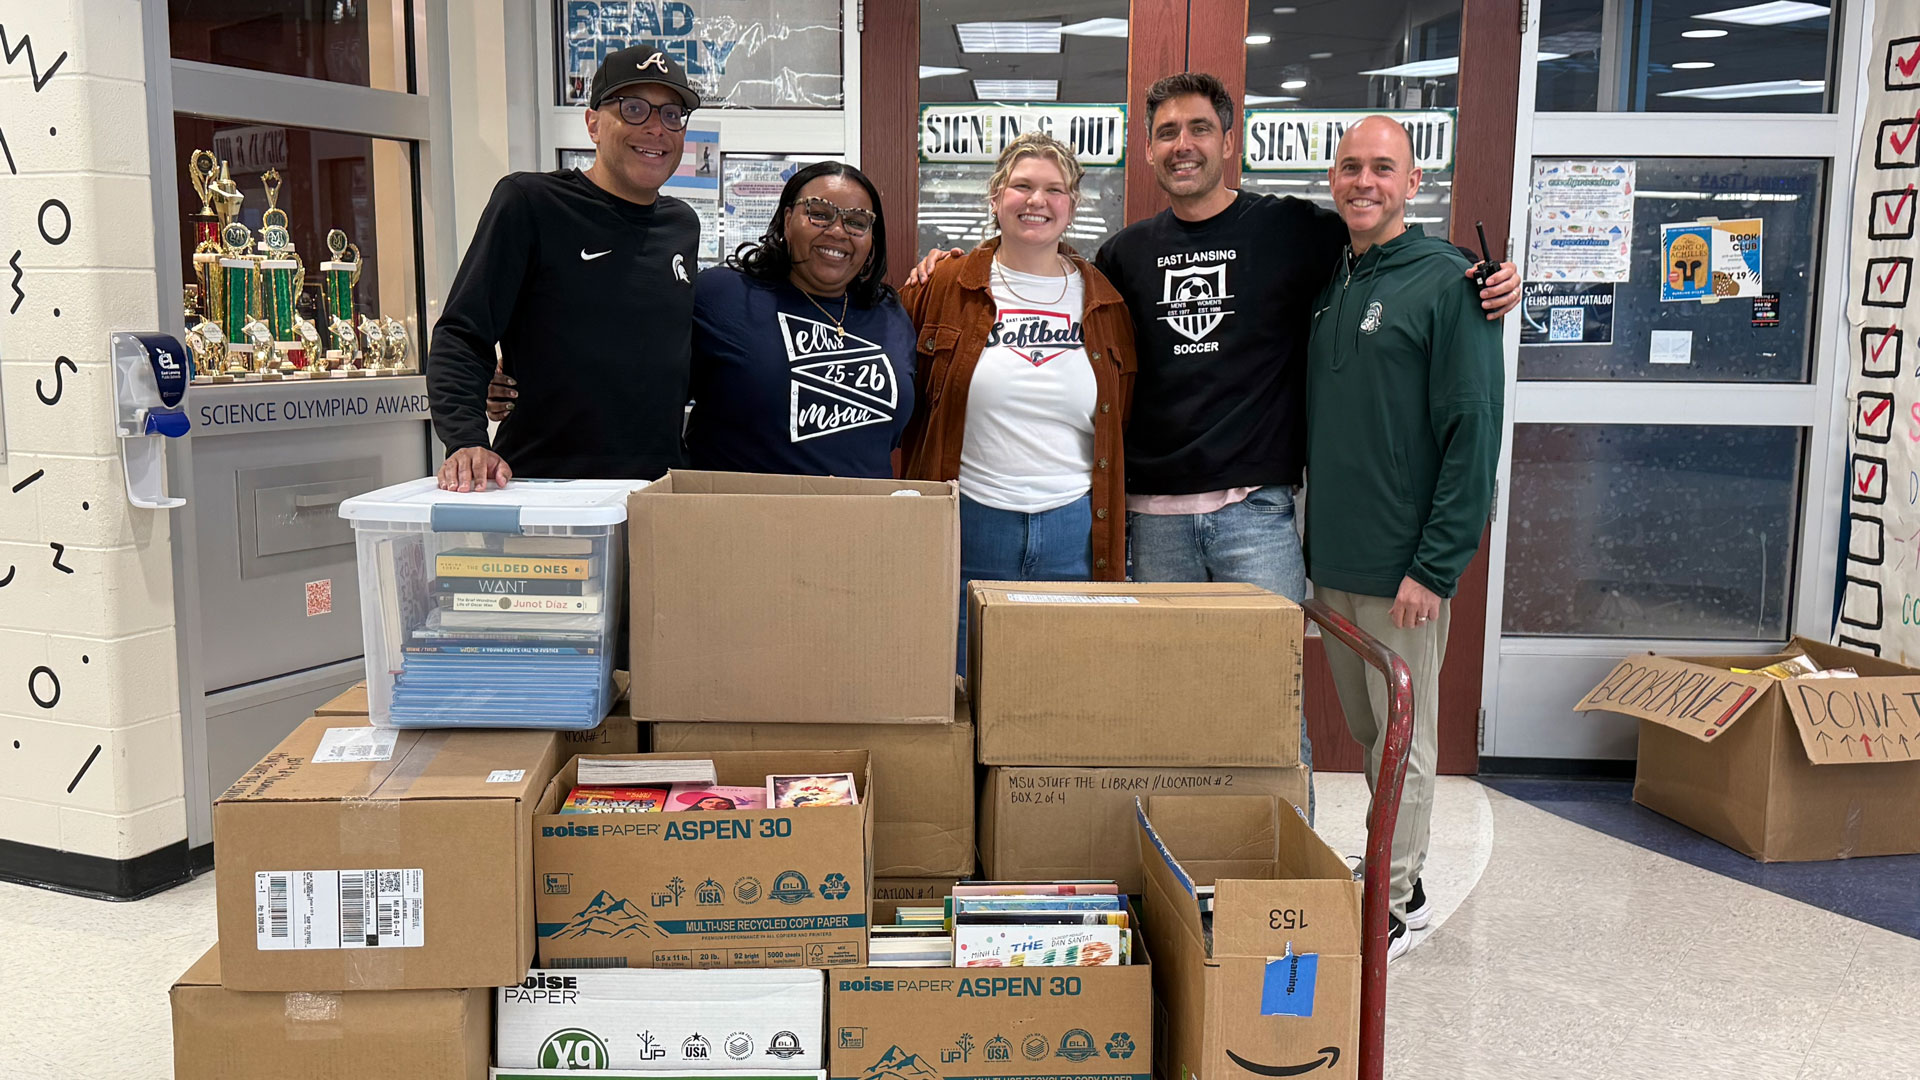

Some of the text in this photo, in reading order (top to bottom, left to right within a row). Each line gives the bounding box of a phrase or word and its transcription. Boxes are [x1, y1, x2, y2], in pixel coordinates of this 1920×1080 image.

[568, 1, 694, 36] READ
[636, 52, 669, 74] A
[926, 114, 984, 155] SIGN
[1070, 115, 1119, 156] OUT
[1250, 121, 1311, 162] SIGN
[1730, 233, 1758, 242] BOOK
[1672, 243, 1693, 252] SONG
[1732, 242, 1758, 251] CLUB
[1157, 249, 1237, 267] EAST LANSING
[1670, 250, 1708, 258] ACHILLES
[1713, 271, 1747, 280] MAY 19
[1528, 294, 1612, 306] ELHS LIBRARY CATALOG
[985, 320, 1086, 349] Softball
[1173, 341, 1219, 355] SOCCER
[824, 363, 886, 391] 25-26
[201, 402, 276, 426] SCIENCE
[283, 397, 368, 421] OLYMPIAD
[481, 563, 529, 573] GILDED
[533, 565, 568, 574] ONES
[478, 580, 528, 593] WANT
[513, 599, 542, 609] Junot
[545, 599, 568, 609] Díaz
[1009, 776, 1035, 789] MSU
[1038, 776, 1071, 789] STUFF
[1073, 776, 1095, 789] THE
[1101, 776, 1149, 790] LIBRARY
[1224, 774, 1234, 786] 2
[1011, 792, 1066, 804] BOX 2 of 4
[663, 819, 751, 841] ASPEN
[759, 818, 792, 838] 30
[699, 892, 721, 904] USA
[927, 885, 935, 900] 1
[651, 895, 673, 907] UP
[686, 916, 849, 932] MULTI-USE RECYCLED COPY PAPER
[1269, 908, 1309, 930] 153
[1010, 940, 1044, 953] THE
[1051, 934, 1094, 948] DAN SANTAT
[956, 976, 1042, 998] ASPEN
[1050, 976, 1082, 996] 30
[640, 1049, 666, 1061] UP
[685, 1047, 707, 1058] USA
[940, 1051, 962, 1063] UP
[987, 1048, 1009, 1060] USA
